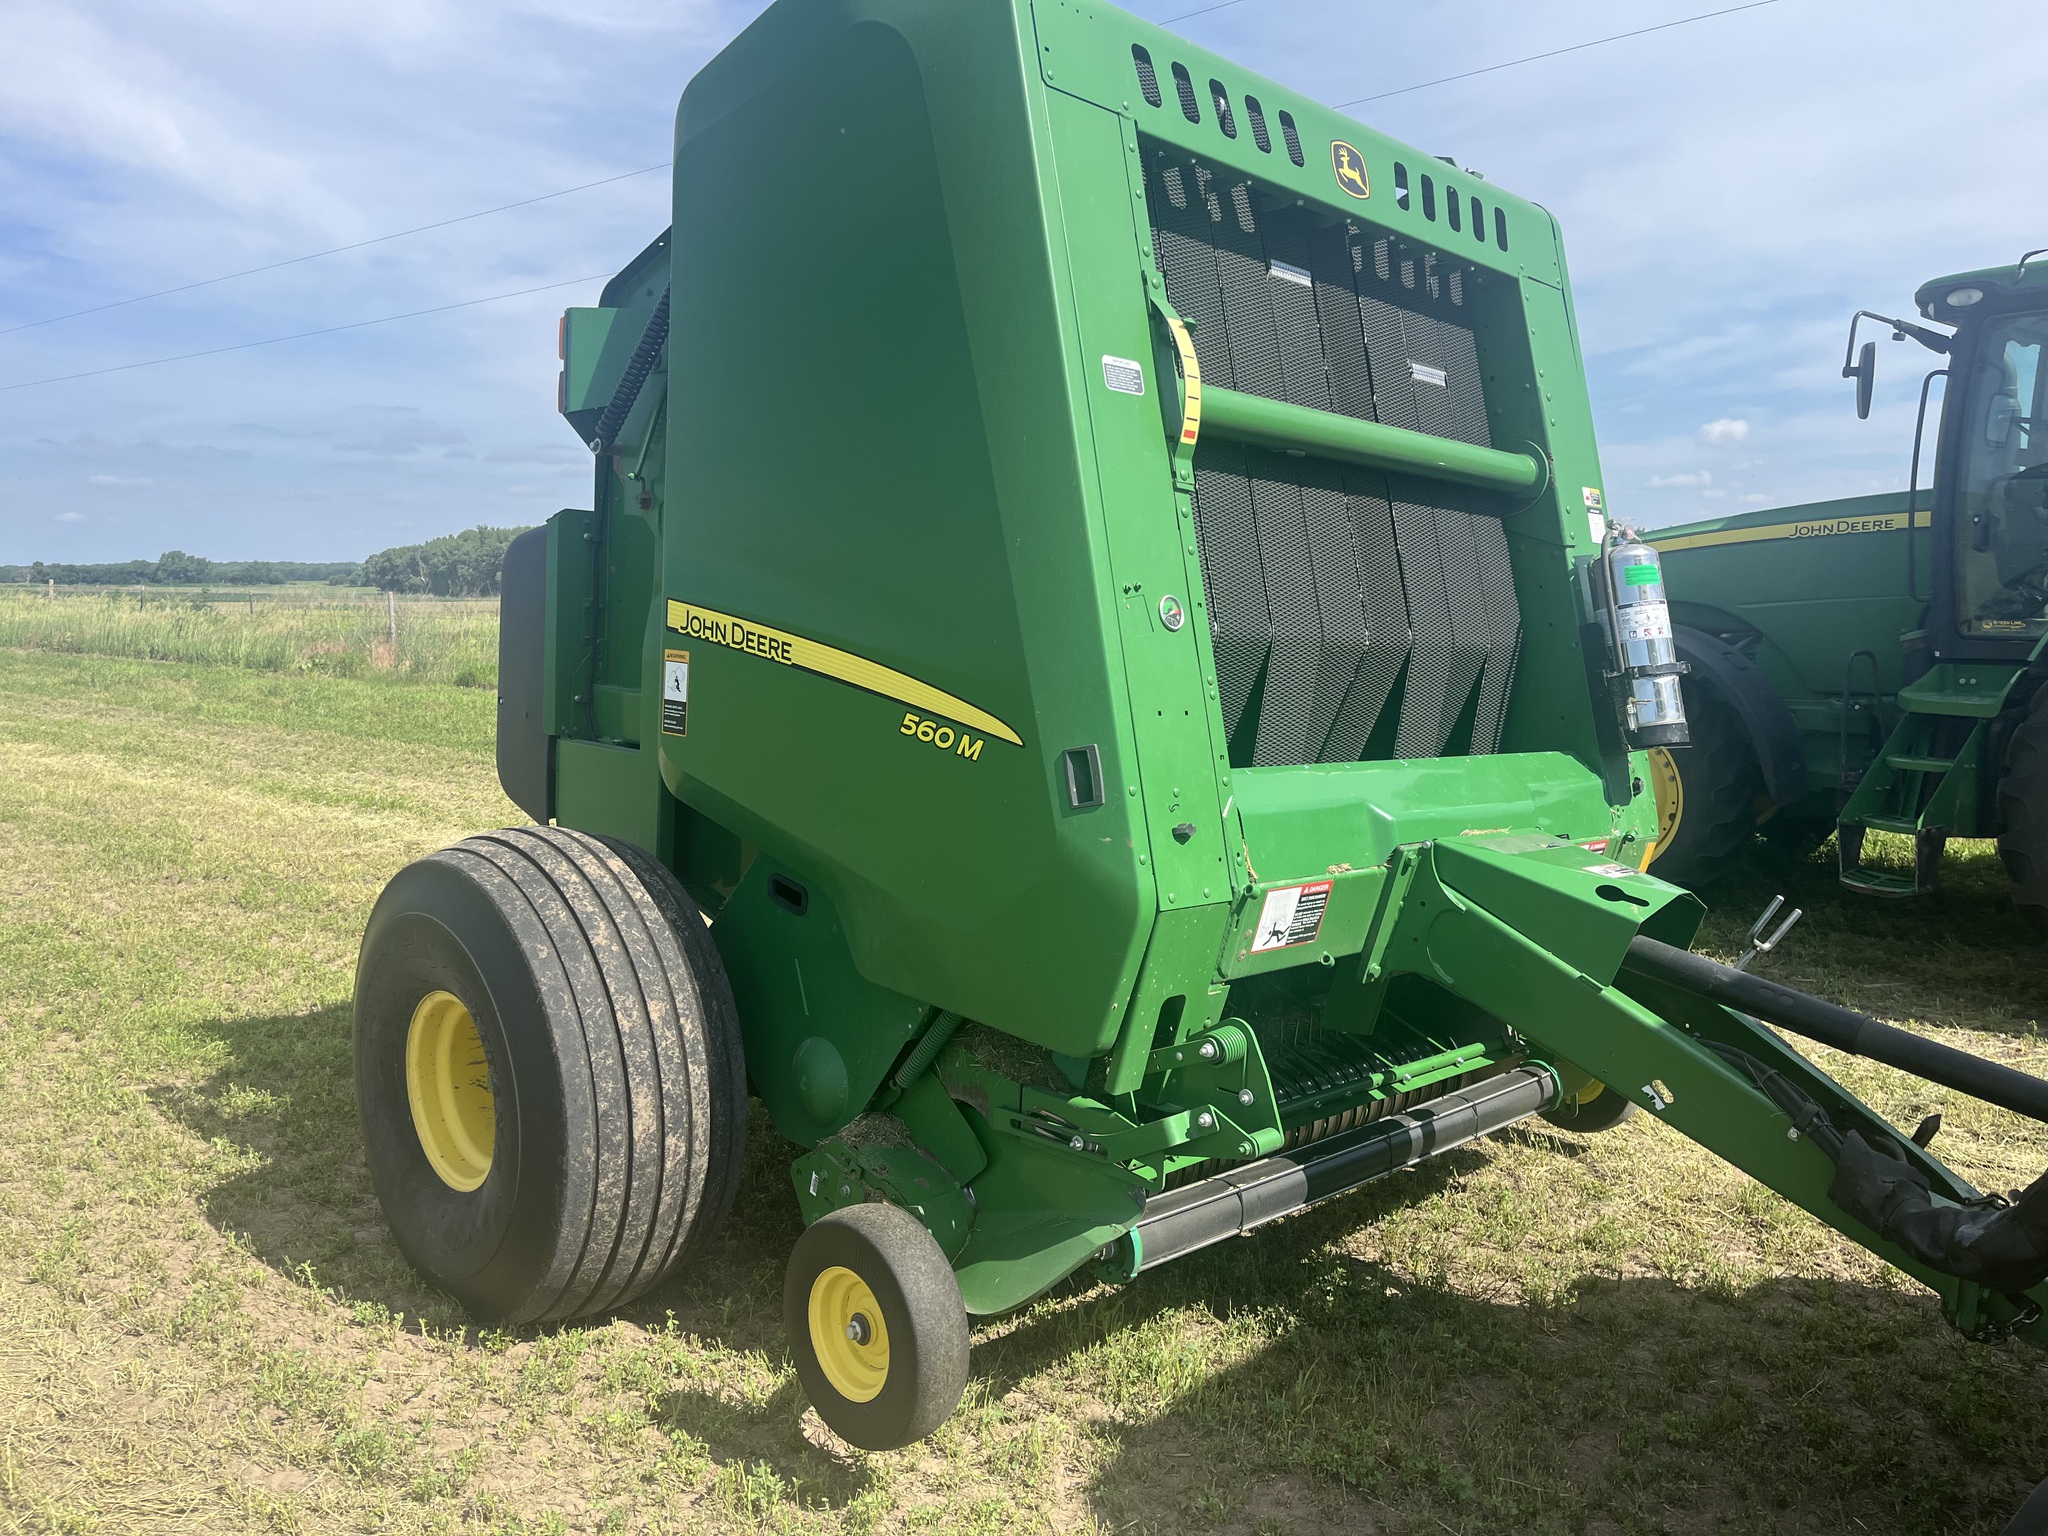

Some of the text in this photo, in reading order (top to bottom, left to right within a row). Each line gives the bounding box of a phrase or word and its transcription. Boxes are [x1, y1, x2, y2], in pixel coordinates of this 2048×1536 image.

[1788, 519, 1895, 537] JOHN DEERE
[680, 609, 793, 662] JOHN DEERE
[900, 712, 985, 761] 560 M
